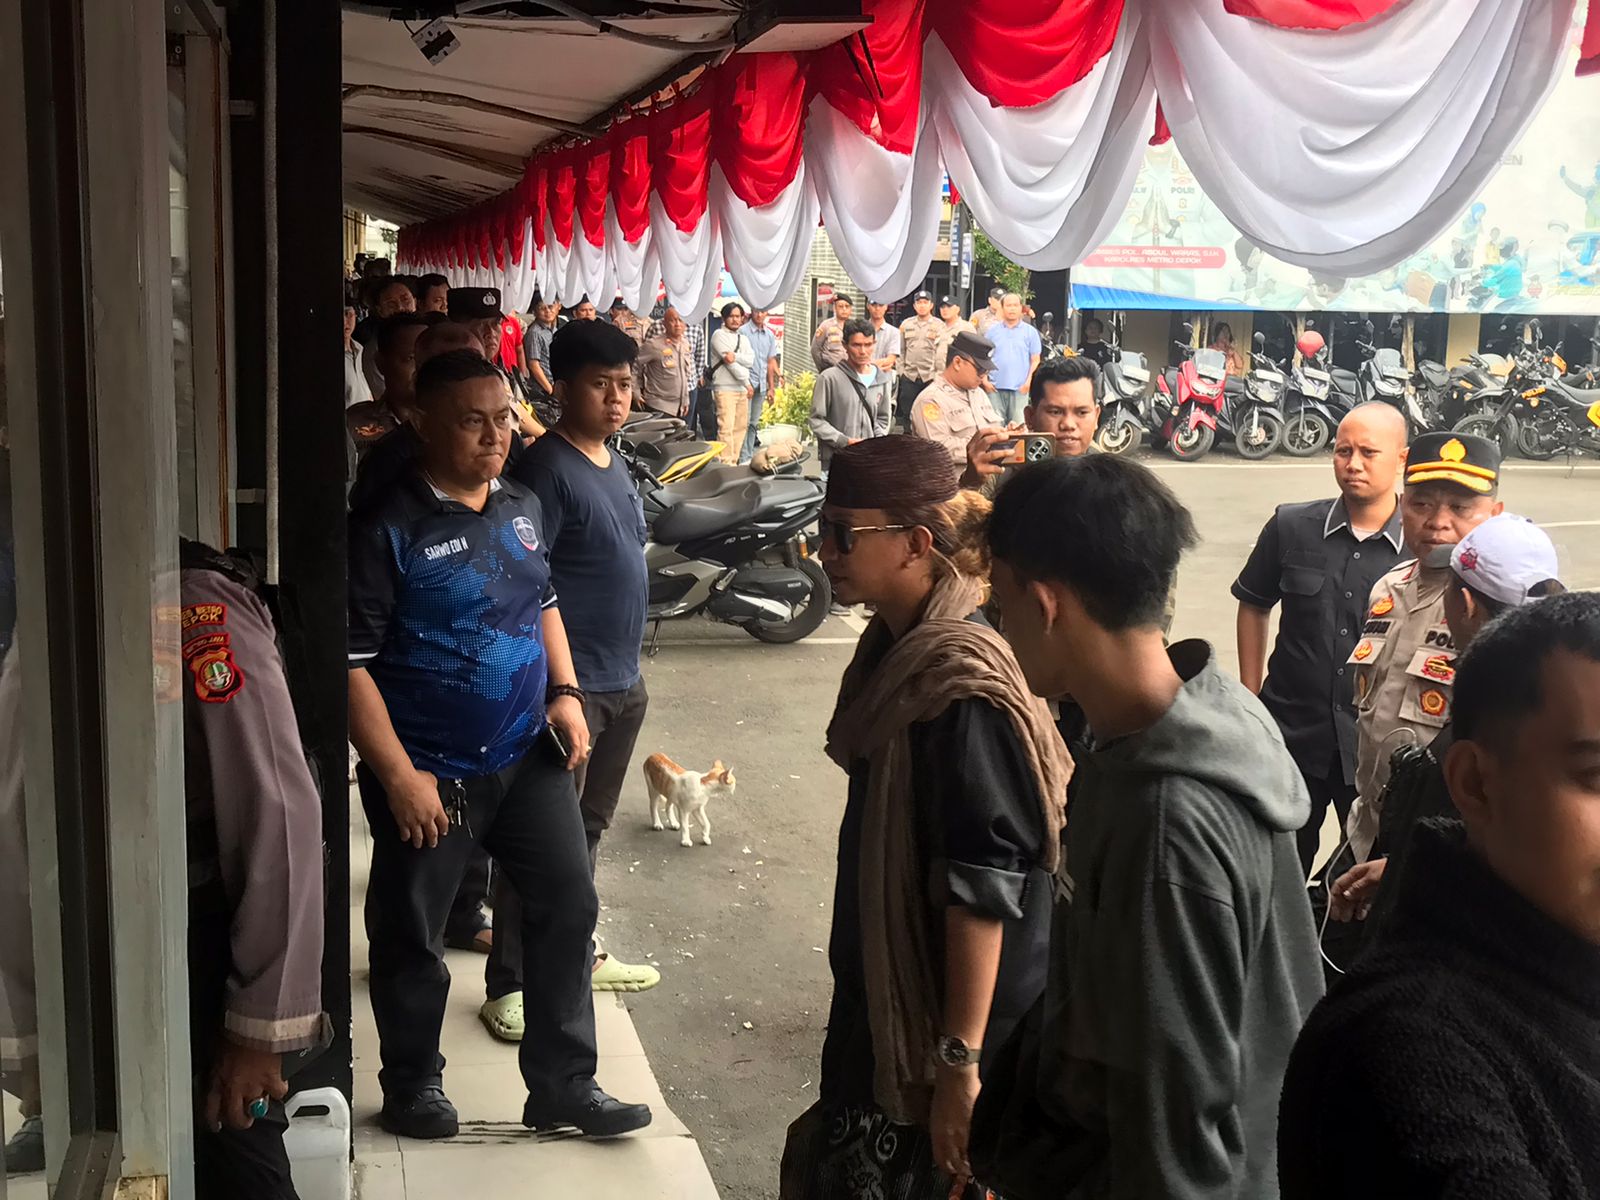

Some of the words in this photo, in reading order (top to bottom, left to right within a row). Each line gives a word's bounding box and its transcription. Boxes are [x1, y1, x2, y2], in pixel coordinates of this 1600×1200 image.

[1146, 257, 1175, 265] METRO
[1175, 257, 1202, 265] DEPOK
[424, 542, 450, 560] SARWO
[182, 611, 219, 628] EPOK
